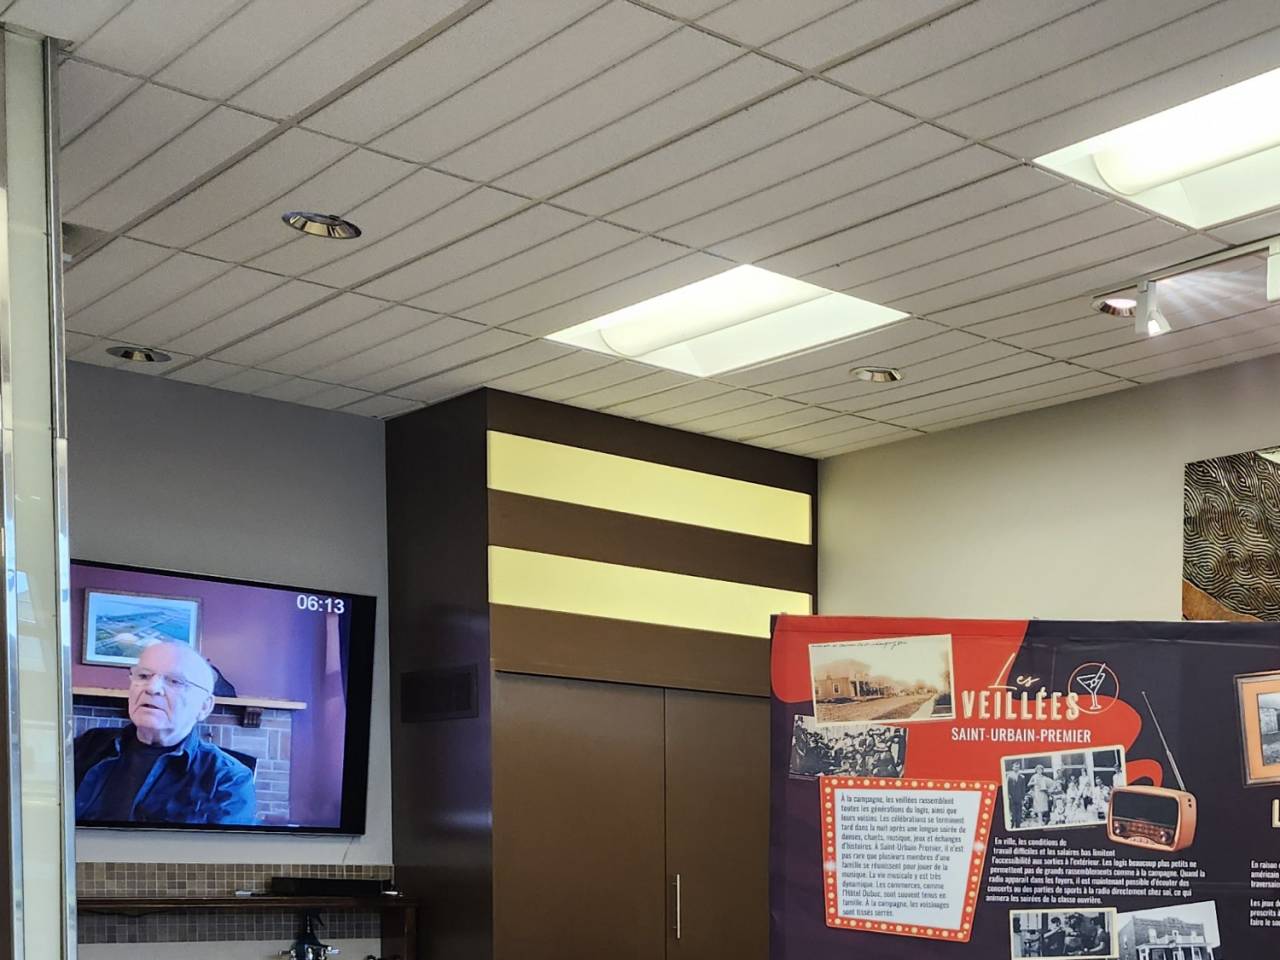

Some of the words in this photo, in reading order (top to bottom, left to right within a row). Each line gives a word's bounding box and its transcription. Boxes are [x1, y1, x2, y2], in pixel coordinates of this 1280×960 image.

[297, 595, 345, 613] 06:13
[988, 653, 1040, 689] Les
[961, 686, 1080, 721] VEILLÉES
[951, 727, 1091, 744] SAINT-URBAIN-PREMIER
